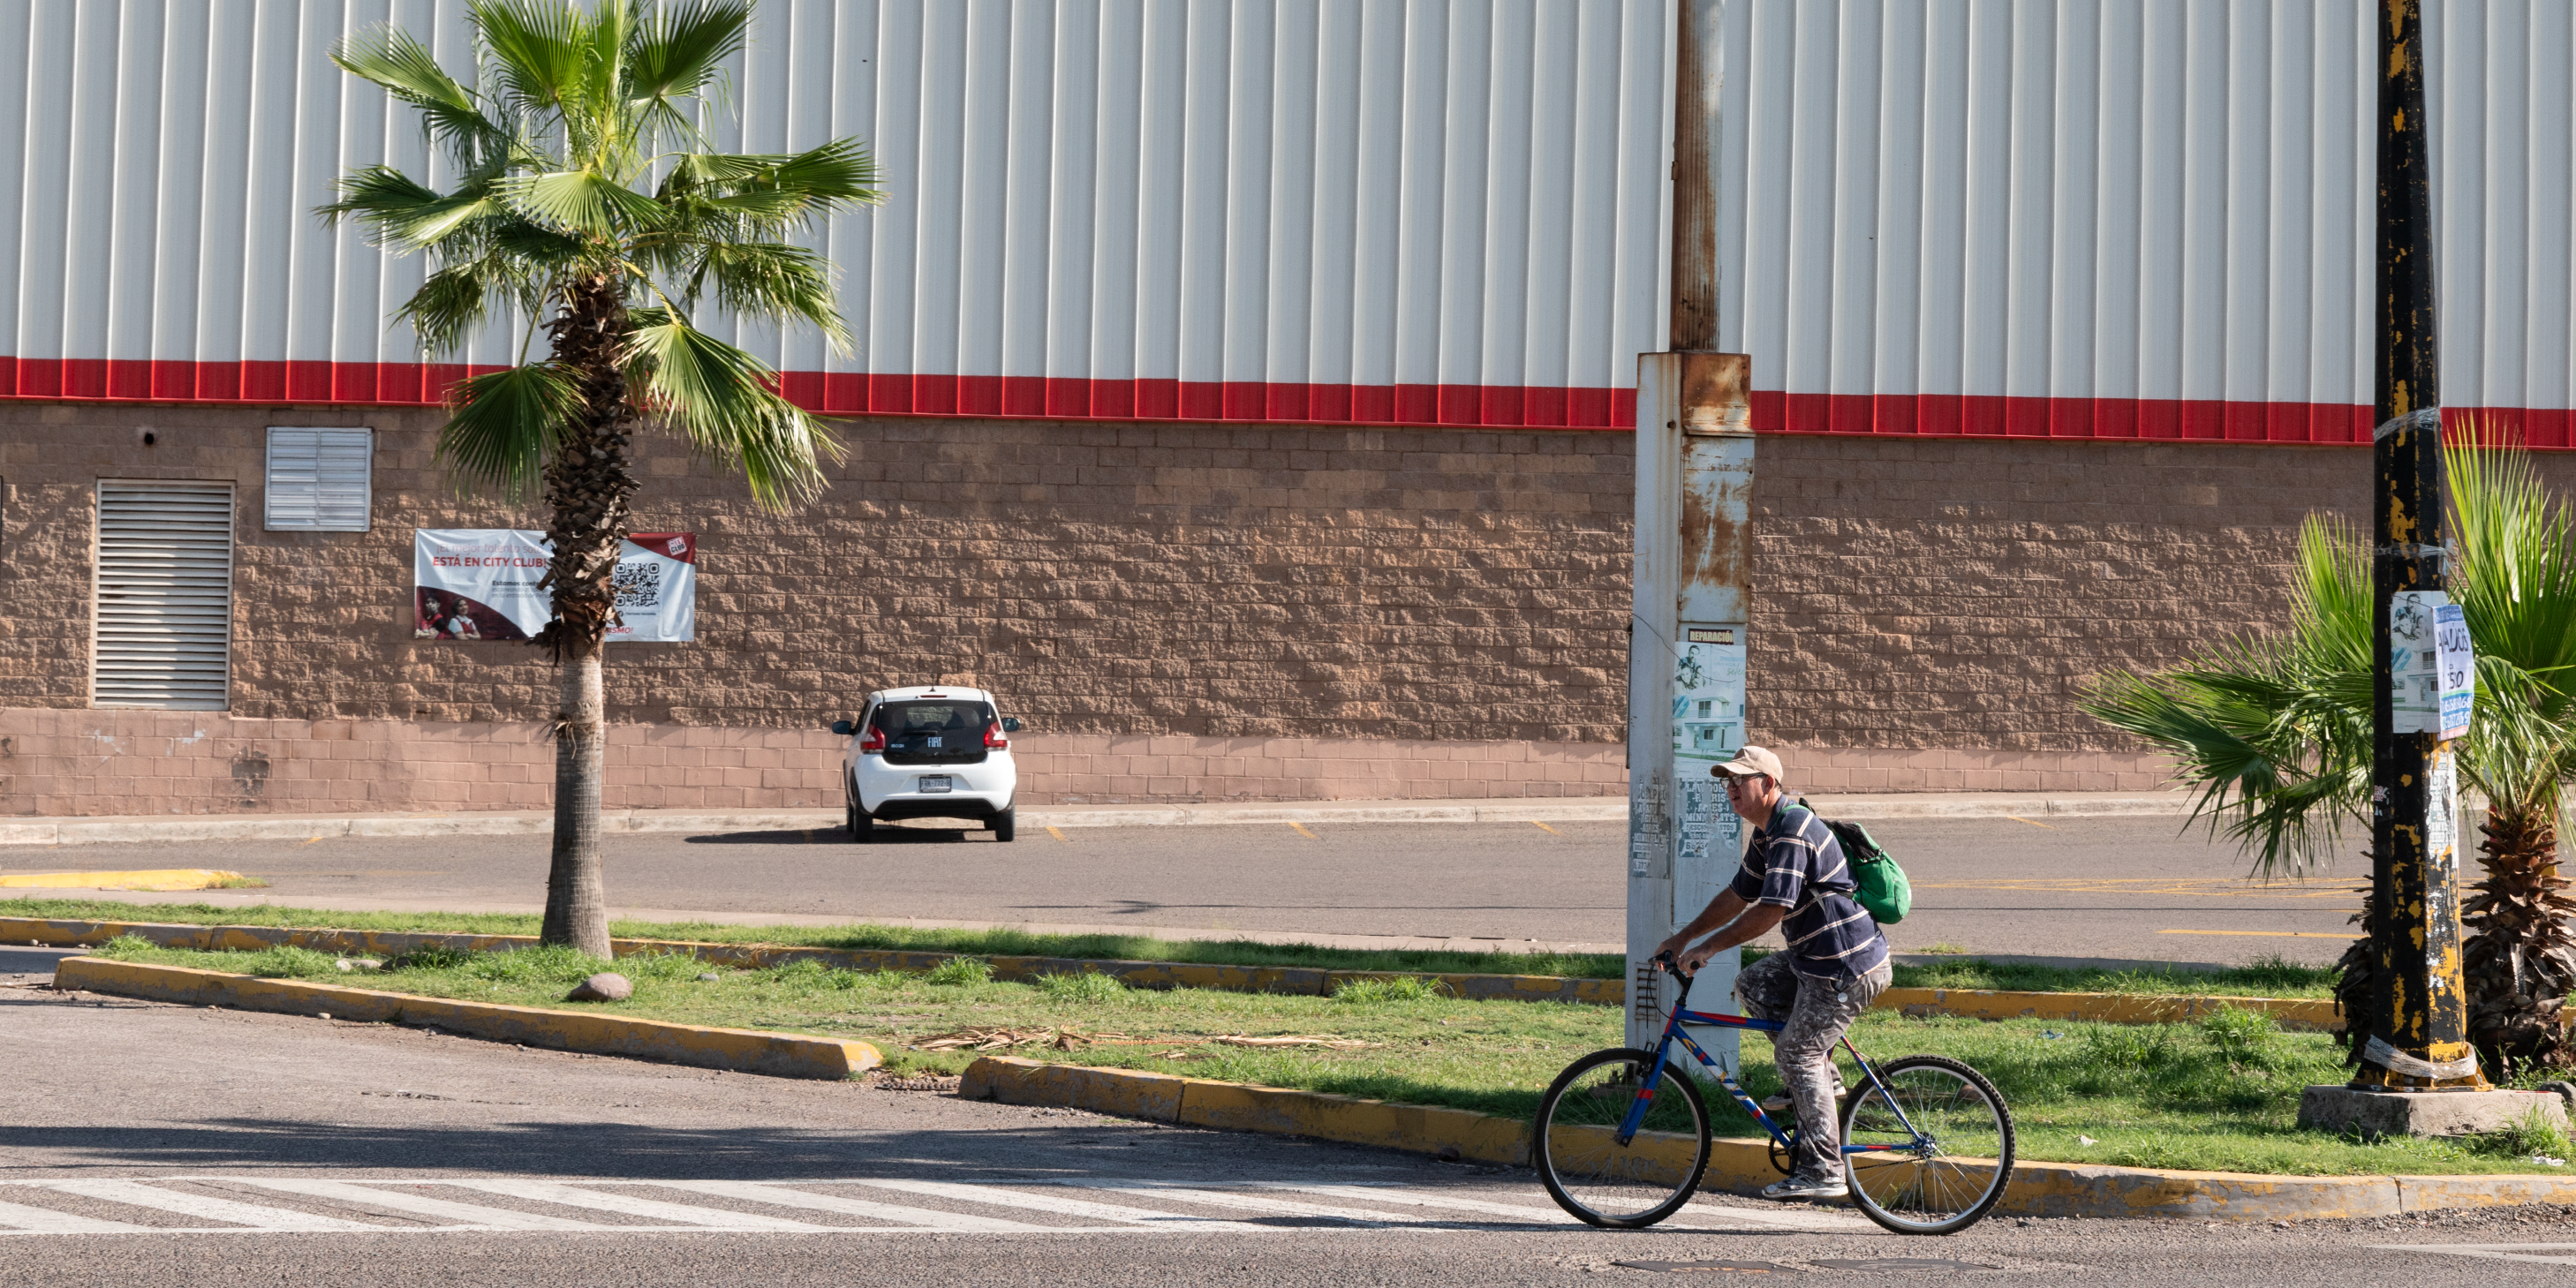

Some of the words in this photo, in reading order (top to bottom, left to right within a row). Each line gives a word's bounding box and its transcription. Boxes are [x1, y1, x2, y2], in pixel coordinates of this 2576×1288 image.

[454, 544, 480, 554] mejor
[483, 544, 520, 554] talento
[523, 544, 544, 554] solo
[670, 543, 685, 553] CLUB
[433, 554, 462, 567] ESTÁ
[465, 557, 480, 567] EN
[483, 557, 510, 567] CITY
[512, 557, 548, 568] CLUB!
[927, 736, 942, 748] FIAT
